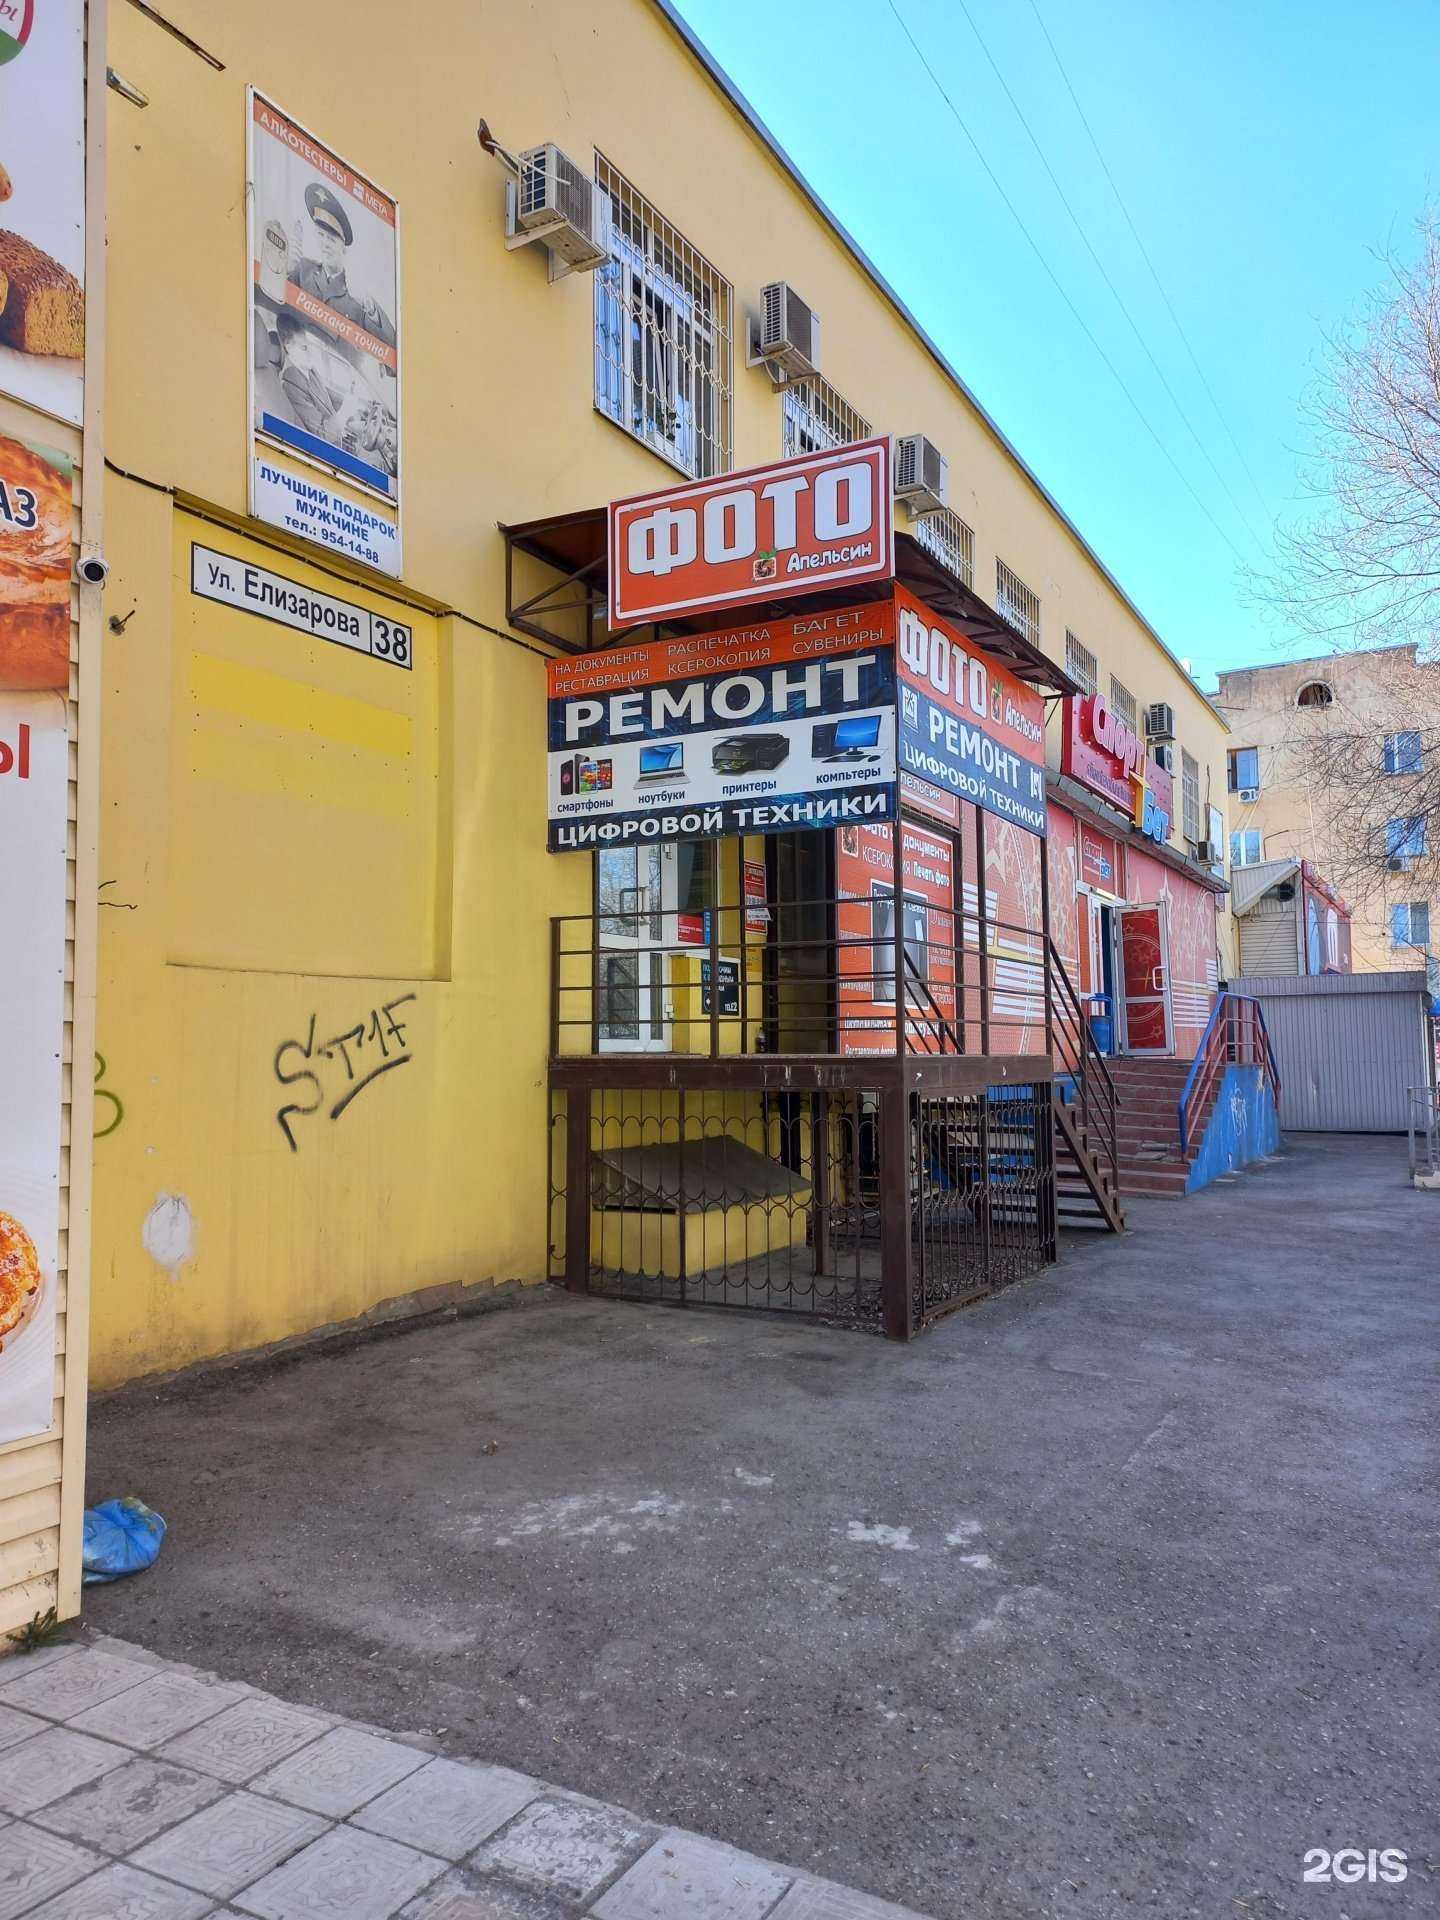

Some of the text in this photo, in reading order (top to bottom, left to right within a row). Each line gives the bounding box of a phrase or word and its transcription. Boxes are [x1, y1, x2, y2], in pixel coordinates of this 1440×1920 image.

[259, 111, 348, 186] АЛКОТЕСТЕРЫ
[296, 291, 390, 361] Работают точно!
[260, 466, 396, 540] ЛУЧШИЙ ПОДАРОК
[296, 499, 369, 542] МУЖЧИНЕ
[628, 462, 873, 577] ФОТО
[285, 515, 379, 564] тел.: 954-14-88
[786, 540, 873, 574] Апельсин
[208, 562, 408, 662] Ул. Елизарова 38
[555, 611, 864, 676] НА ДОКУМЕНТЫ РАСПЕЧАТКА БАГЕТ
[555, 628, 884, 693] РЕСТАВРАЦИЯ КСЕРОКОПИЯ СУВЕНИРЫ
[900, 608, 987, 719] ФОТО
[565, 654, 876, 742] РЕМОНТ
[1005, 697, 1042, 743] Апельсин
[815, 766, 881, 785] компьтеры
[929, 706, 1020, 788] РЕМОНТ
[557, 797, 614, 814] смартфоны
[638, 789, 685, 805] ноутбуки
[722, 779, 777, 796] принтеры
[900, 773, 941, 800] пельсин
[904, 740, 1044, 829] ЦИФРОВОЙ ТЕХНИКИ
[558, 793, 886, 847] ЦИФРОВОЙ ТЕХНИКИ
